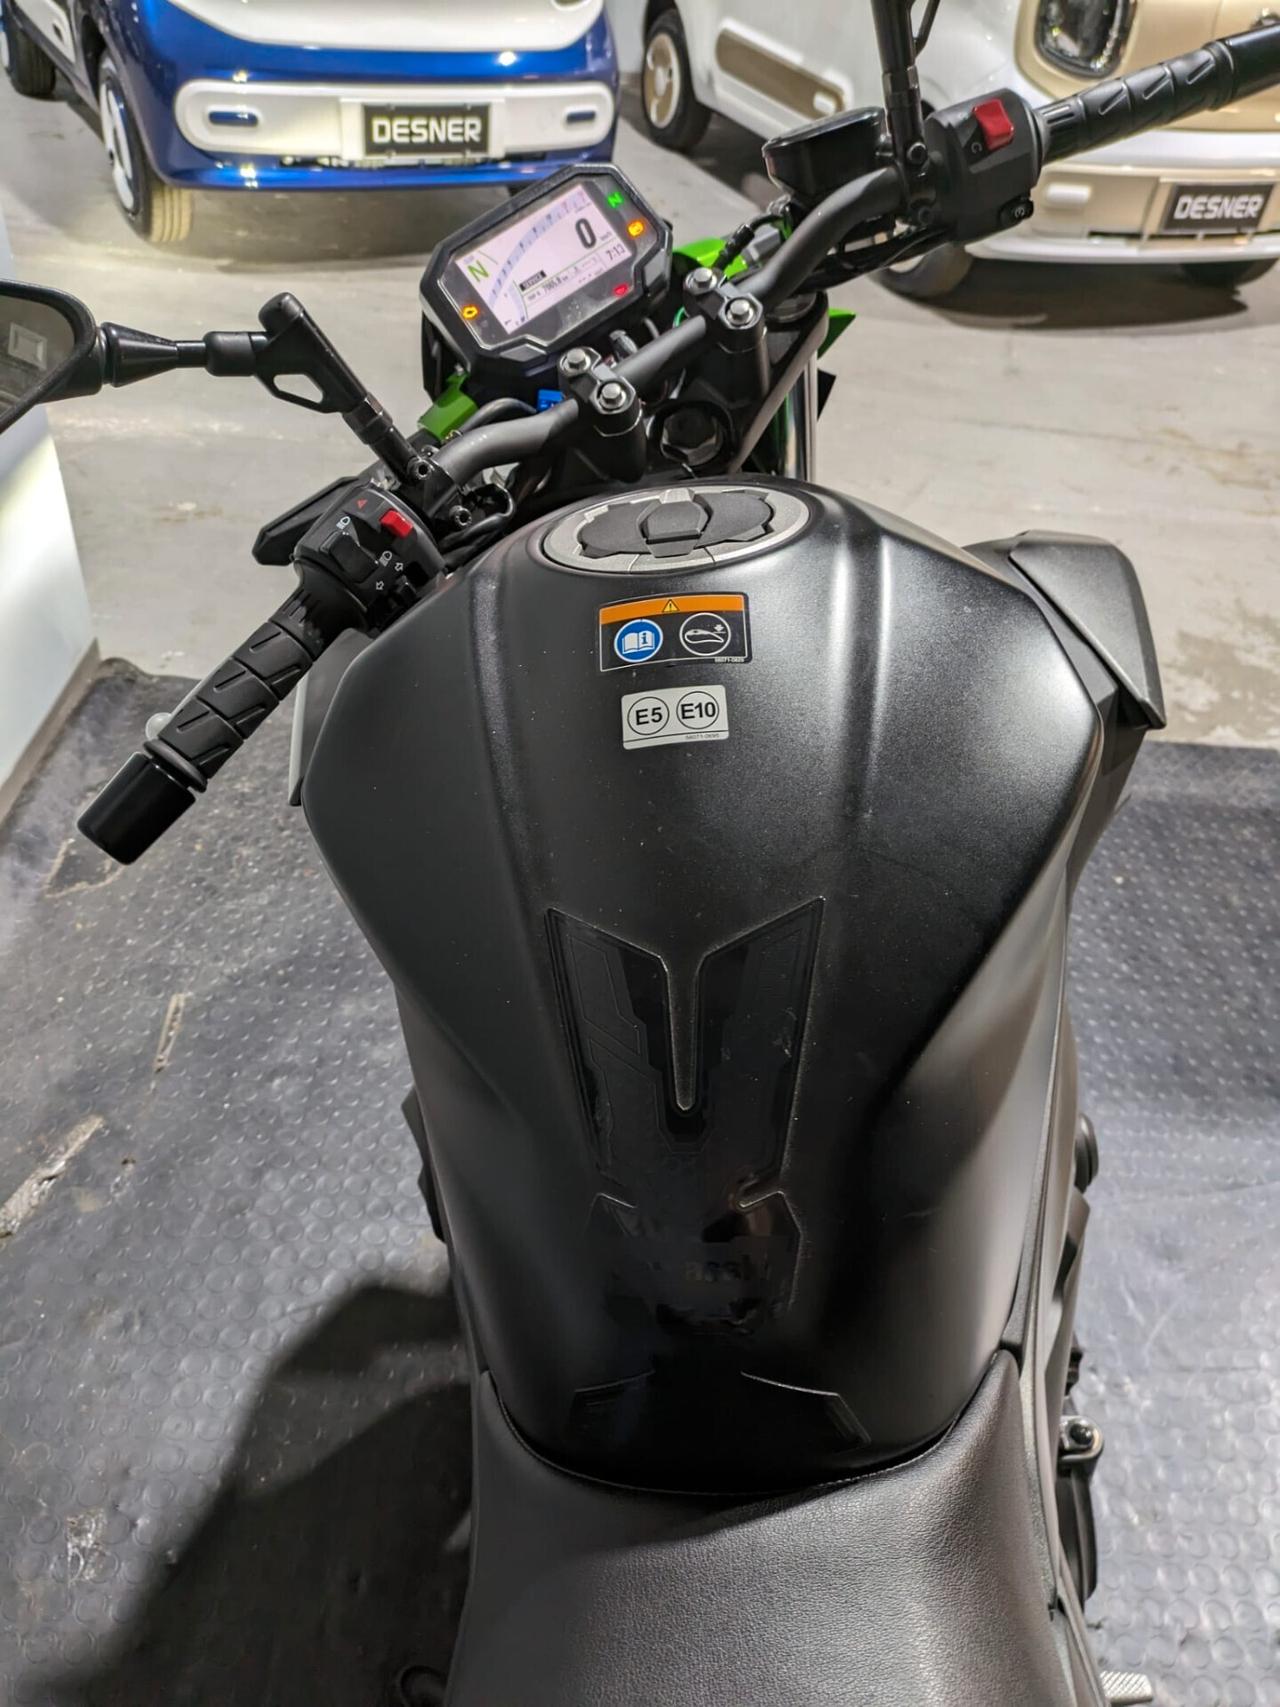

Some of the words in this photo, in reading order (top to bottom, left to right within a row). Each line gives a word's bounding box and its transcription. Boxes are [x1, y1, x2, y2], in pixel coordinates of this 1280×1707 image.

[372, 116, 482, 144] DESNER
[607, 192, 624, 208] N
[1174, 195, 1263, 219] DESNER
[575, 218, 597, 249] 0
[467, 259, 489, 282] N
[635, 707, 663, 726] E5
[681, 702, 716, 720] E10
